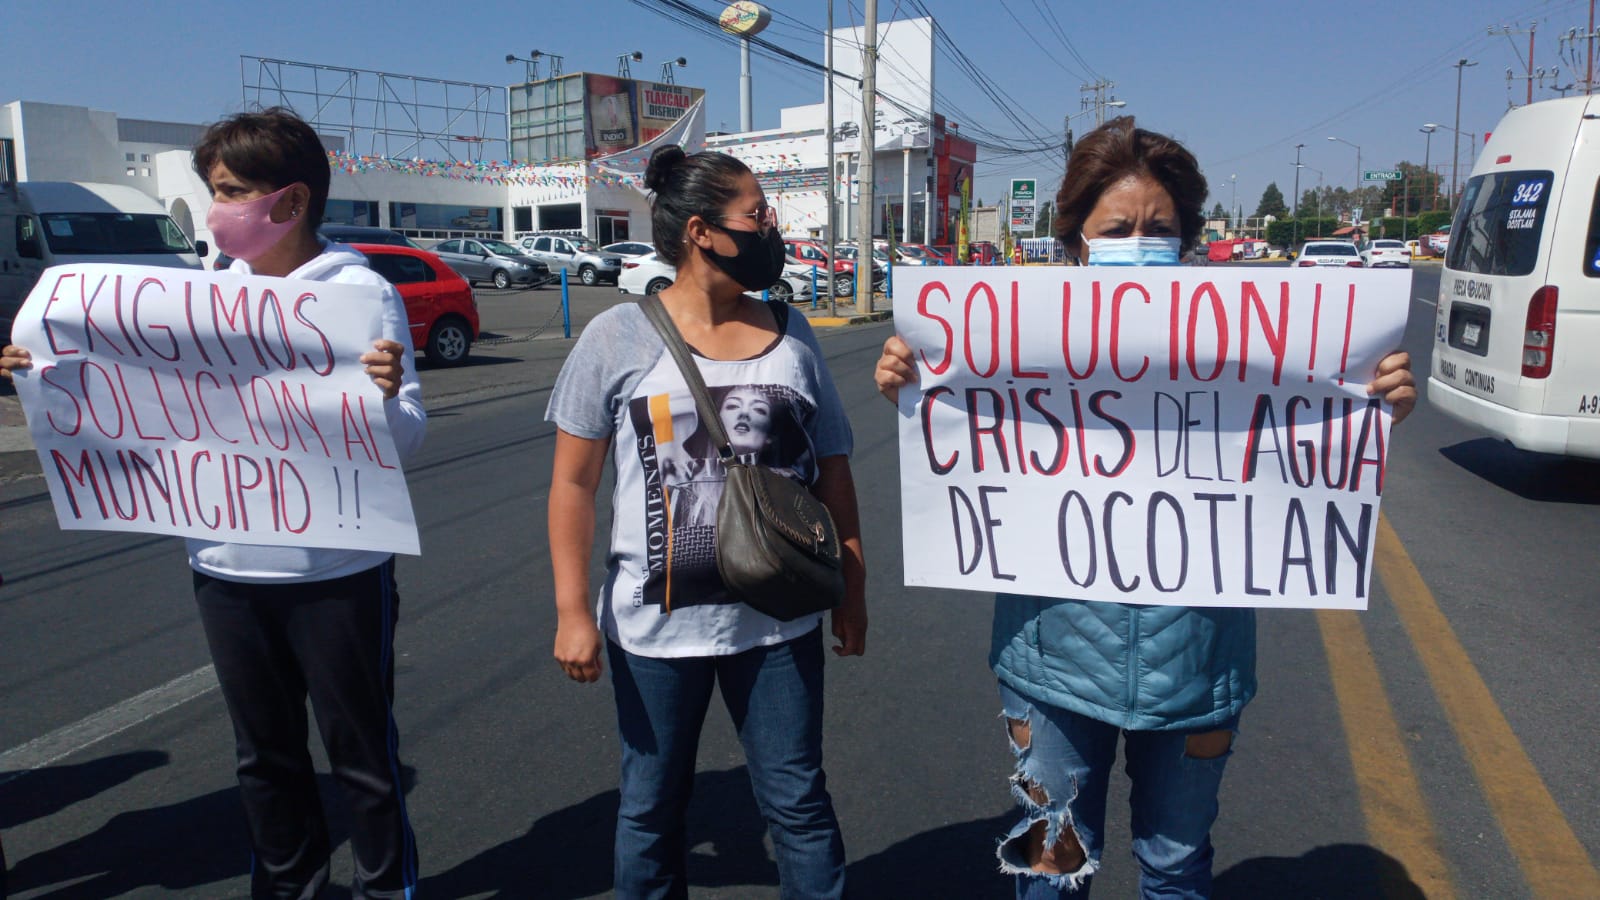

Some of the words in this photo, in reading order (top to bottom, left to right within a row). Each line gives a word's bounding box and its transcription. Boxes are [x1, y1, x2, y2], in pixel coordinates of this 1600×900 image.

[603, 132, 625, 141] INDIO
[645, 90, 690, 109] TLAXCALA
[1369, 172, 1396, 180] ENTRADA
[1512, 182, 1544, 203] 342
[42, 272, 336, 377] EXIGIMOS
[916, 280, 1357, 386] SOLUCION!!
[40, 360, 331, 458] SOLUCION
[340, 392, 397, 469] AL
[1464, 368, 1496, 394] CONTINUAS
[1578, 394, 1600, 414] A-9
[921, 380, 1137, 479] CRISIS
[1153, 391, 1236, 482] DEL
[1241, 394, 1386, 497] AGUA
[50, 447, 312, 534] MUNICIPIO
[637, 434, 664, 573] MOMENTS
[947, 485, 1017, 581] DE
[1057, 489, 1373, 598] OCOTLAN
